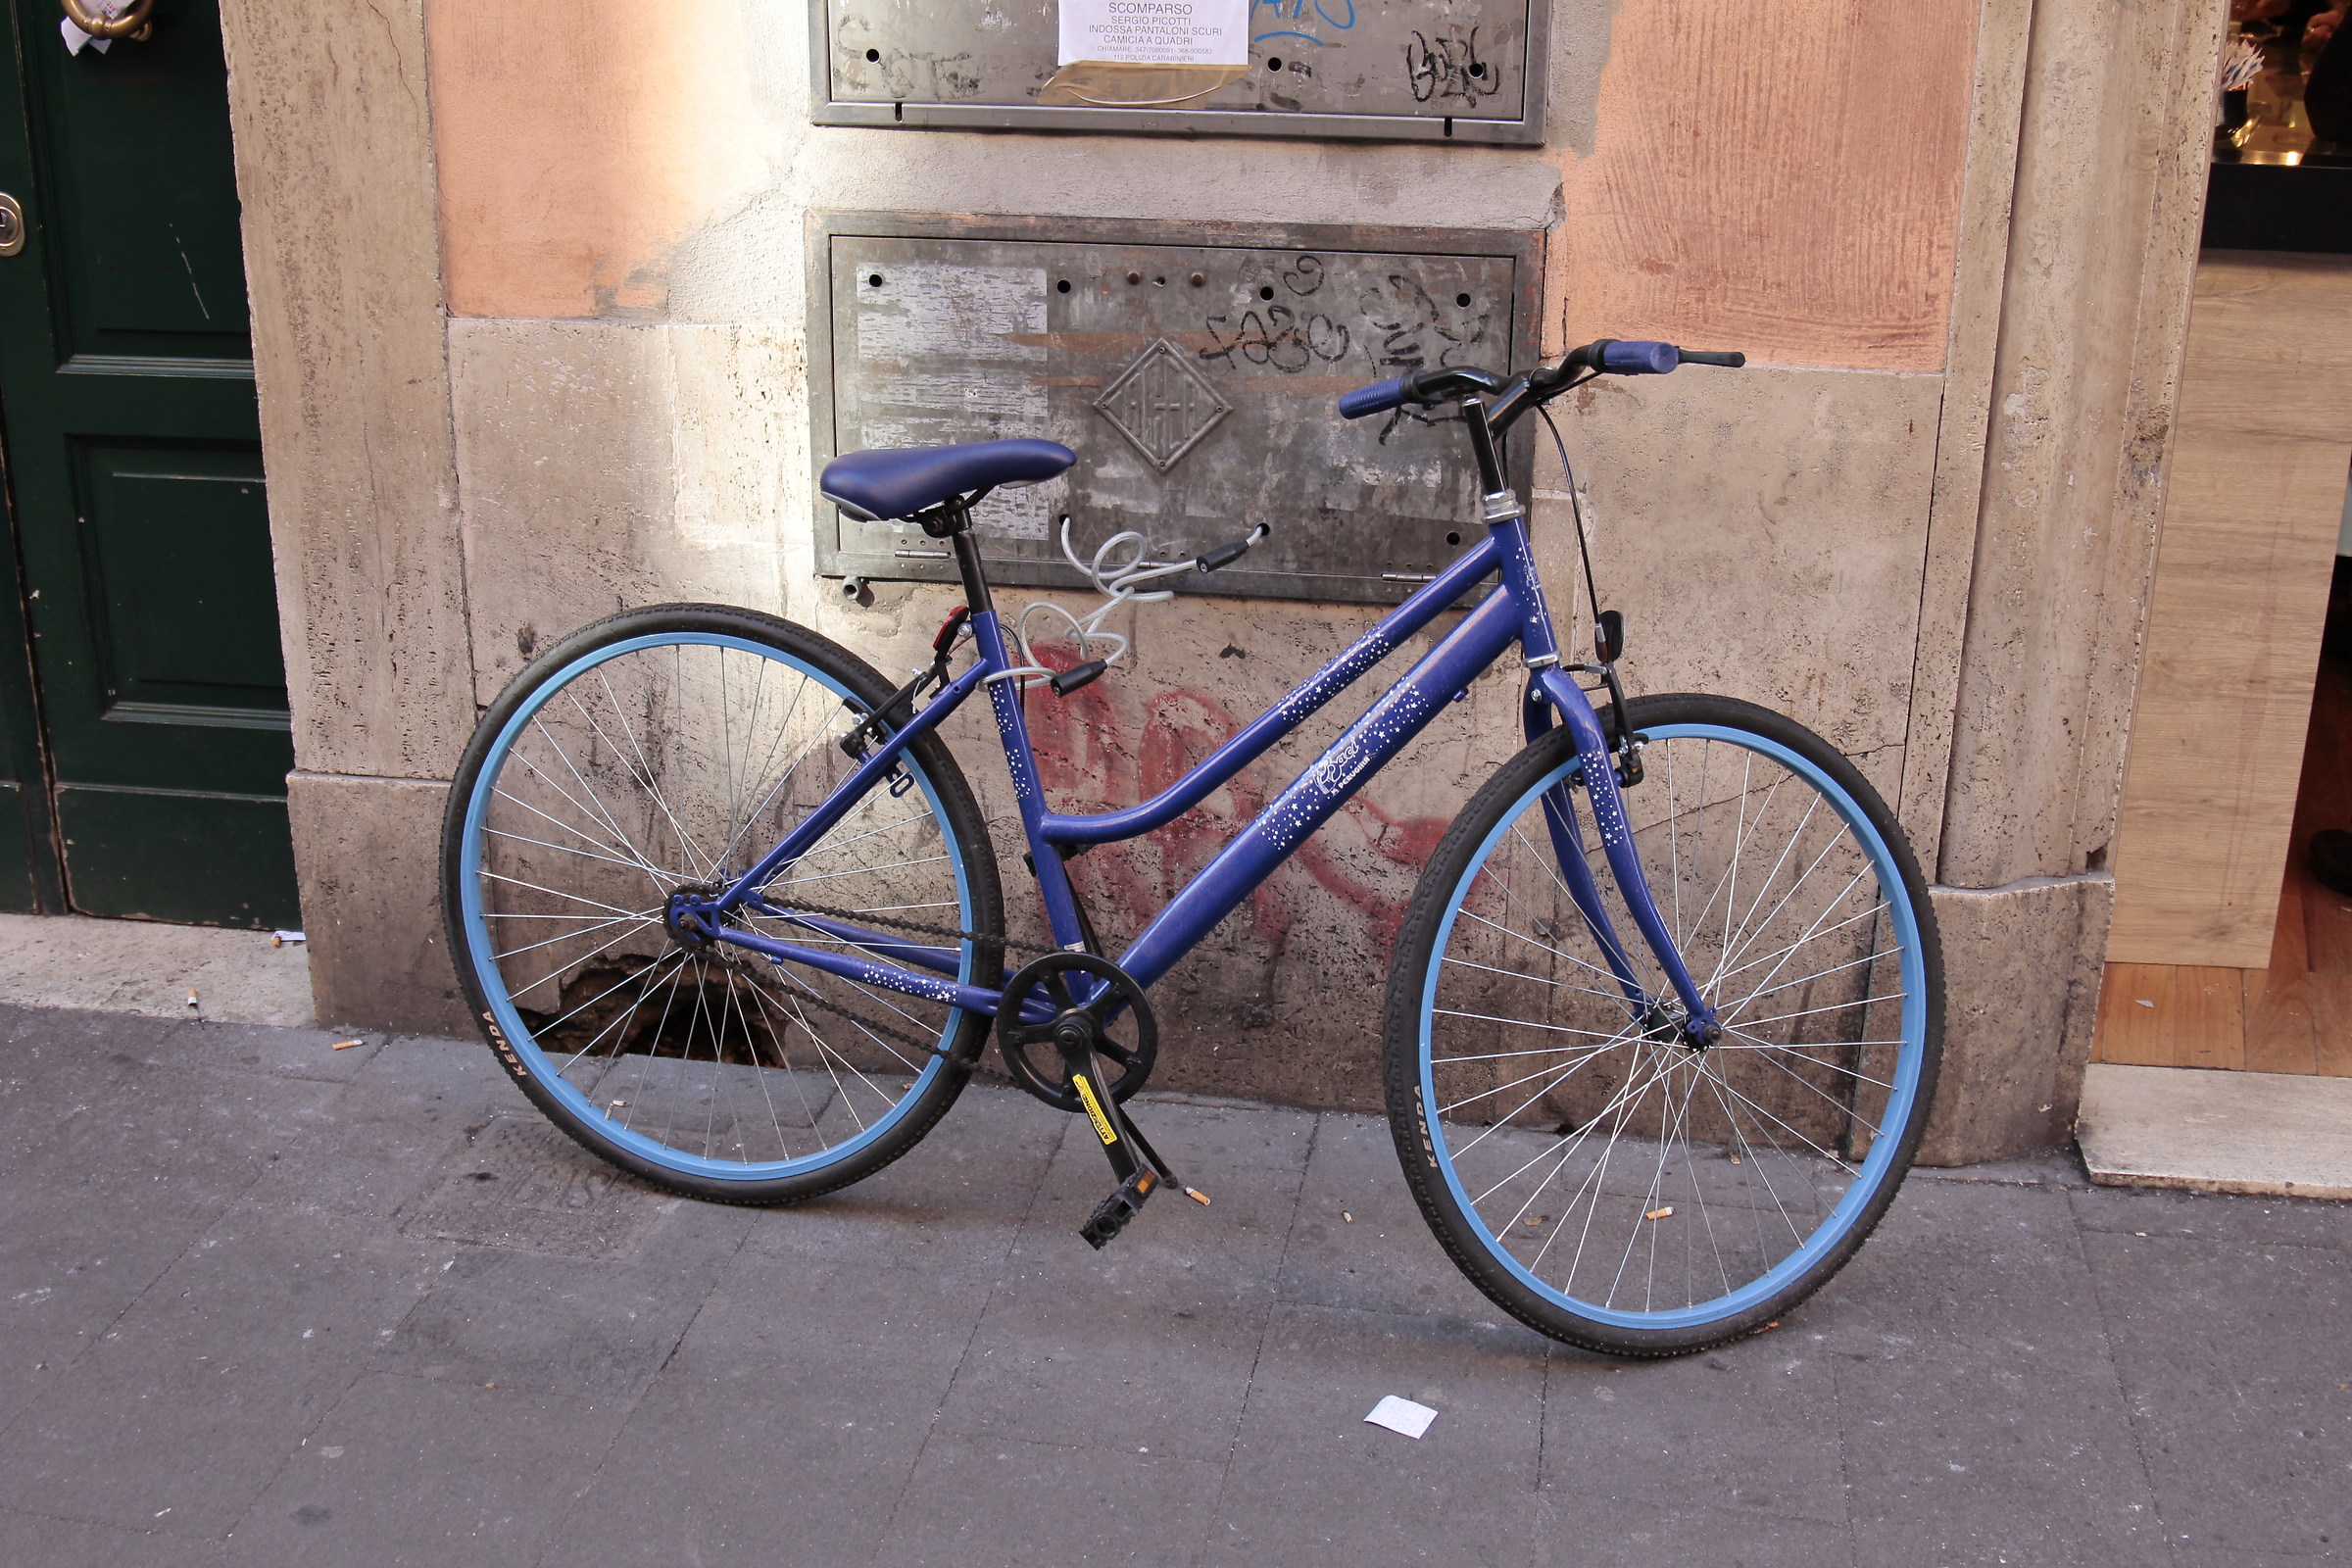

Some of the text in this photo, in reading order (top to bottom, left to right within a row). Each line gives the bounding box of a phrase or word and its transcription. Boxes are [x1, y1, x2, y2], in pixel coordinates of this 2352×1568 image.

[1108, 2, 1193, 15] SCOMPARSO
[1111, 16, 1191, 25] SERGIO PICOTTI
[1089, 24, 1222, 36] INDOSSA PANTALONI SCURI
[1103, 34, 1193, 45] CAMICIA A QUADRI
[482, 1011, 527, 1076] KENDA
[1414, 1085, 1438, 1168] KENDA
